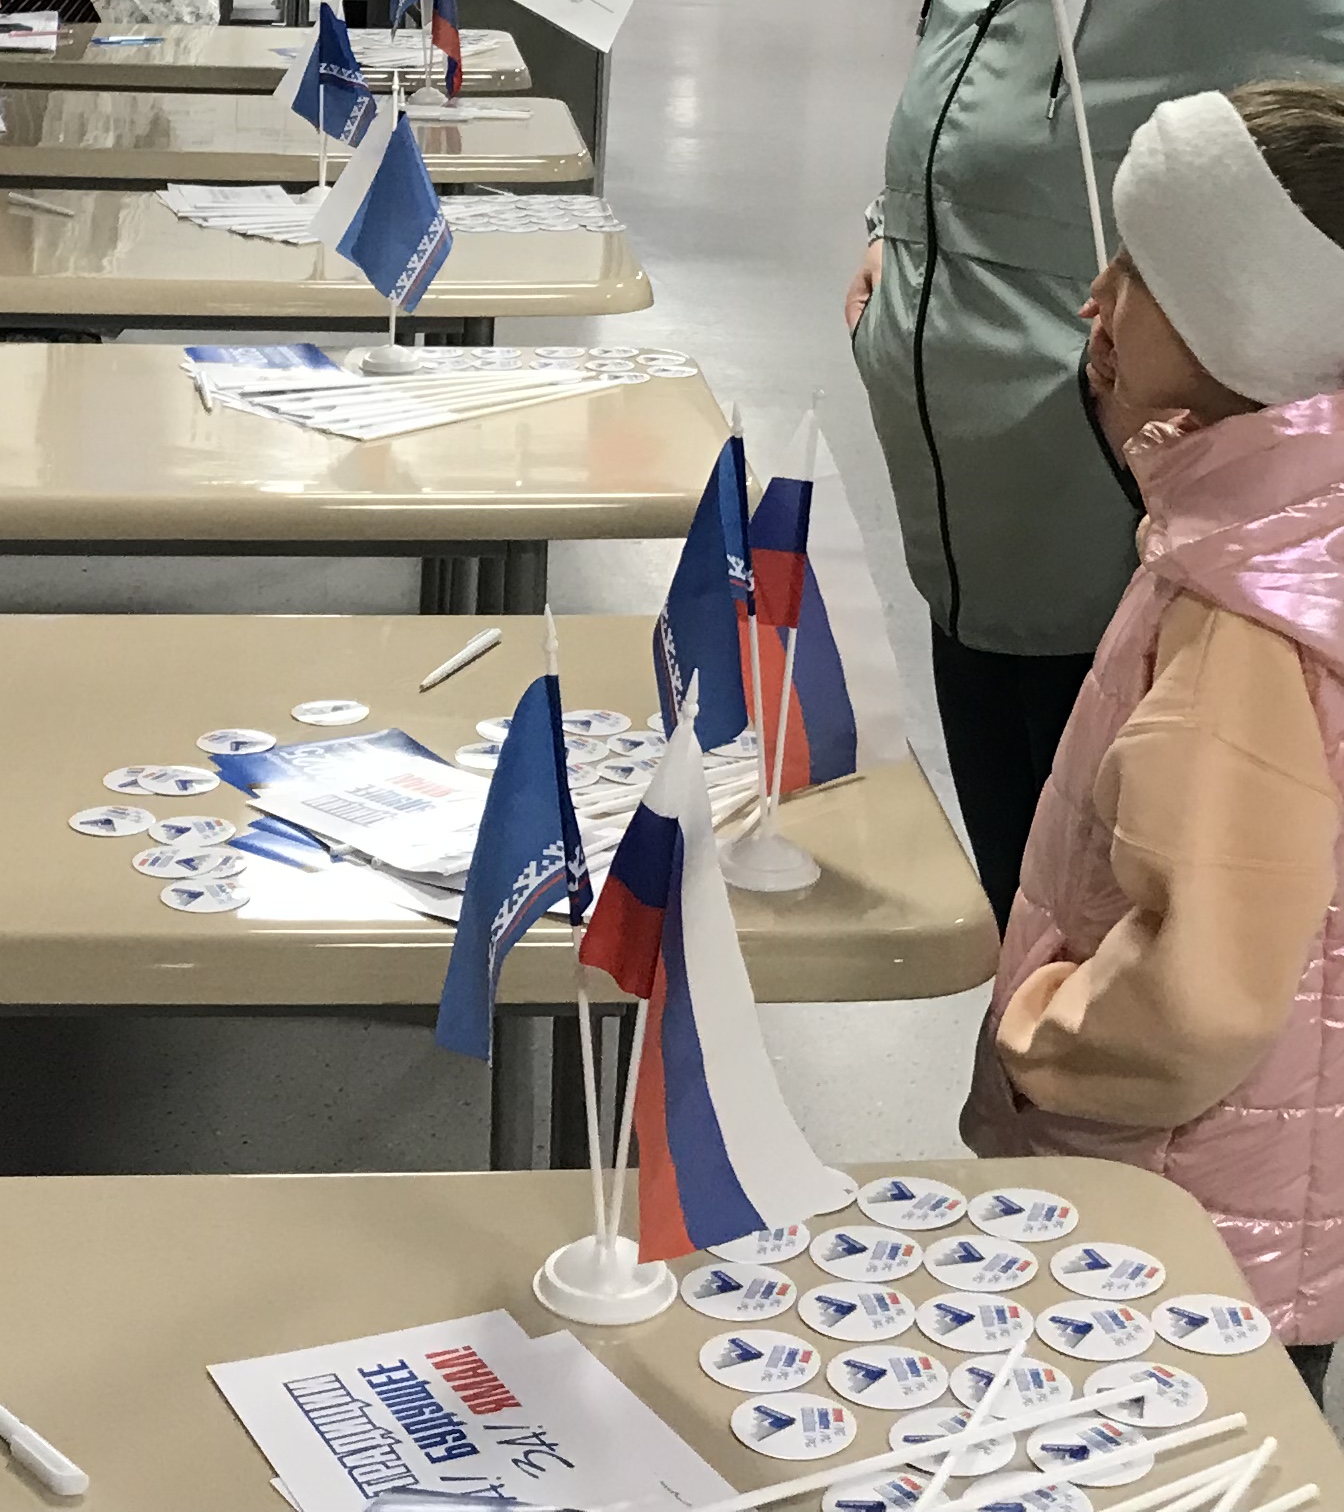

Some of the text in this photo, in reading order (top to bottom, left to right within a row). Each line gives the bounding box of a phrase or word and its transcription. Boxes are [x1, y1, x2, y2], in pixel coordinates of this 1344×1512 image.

[358, 1358, 481, 1465] БУДУЩЕЕ
[424, 1344, 576, 1480] ЗА! ЯМАЛ!
